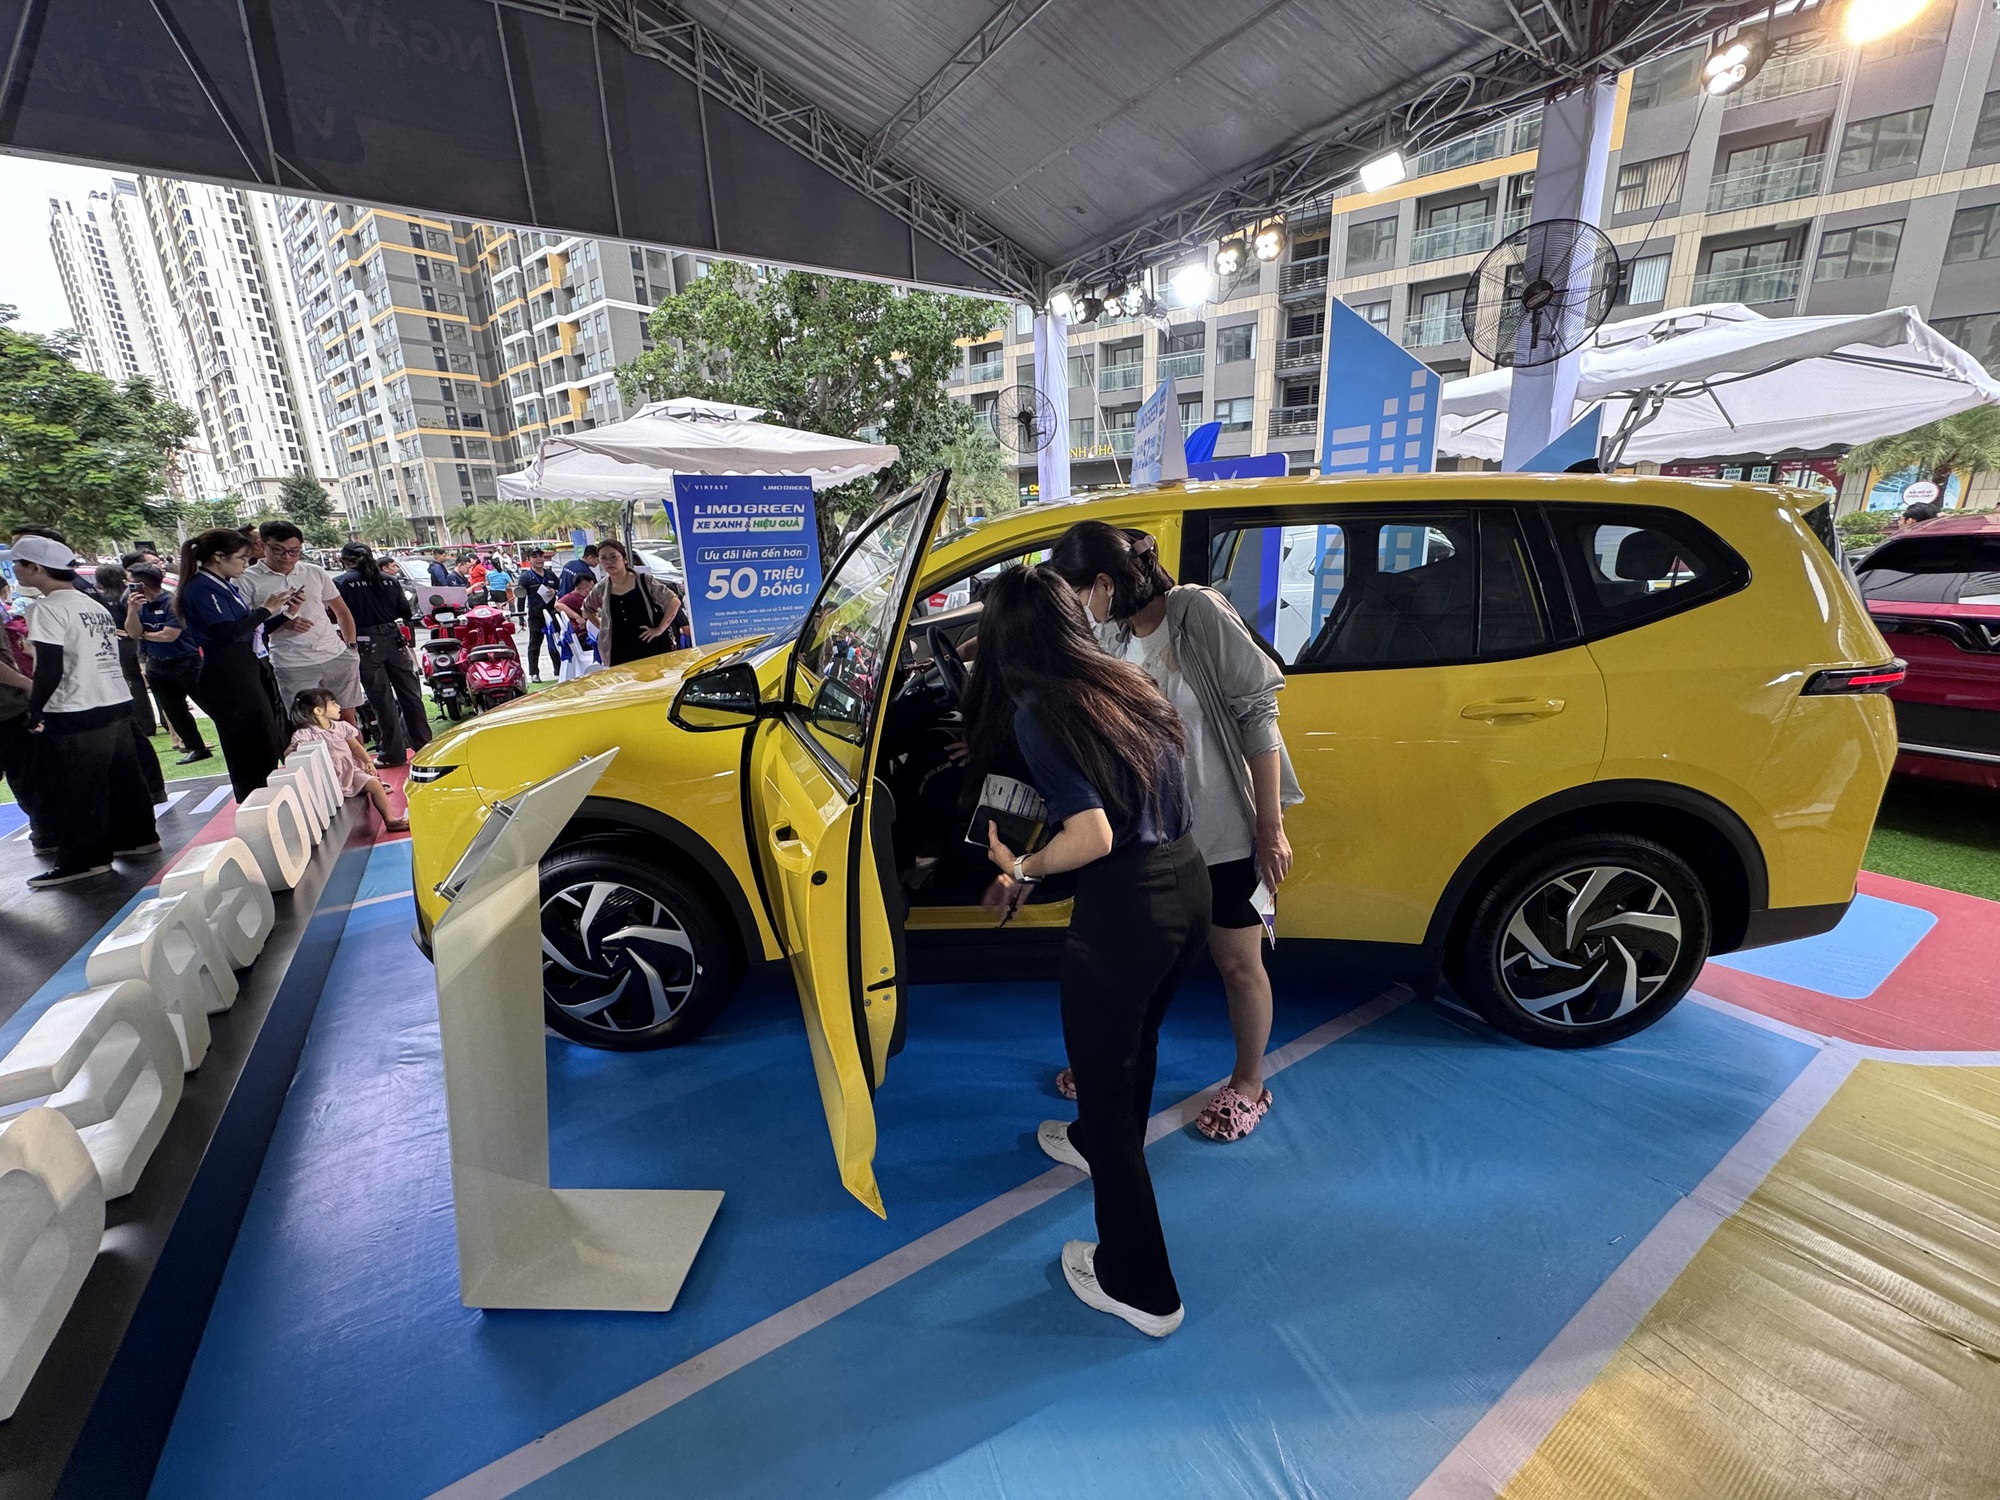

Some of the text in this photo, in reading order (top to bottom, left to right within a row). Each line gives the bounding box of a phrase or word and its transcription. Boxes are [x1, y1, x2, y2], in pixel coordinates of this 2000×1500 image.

[694, 503, 805, 515] LIMO GREEN
[696, 521, 711, 529] XE
[713, 520, 743, 529] XANH
[753, 518, 777, 529] HIỆU
[778, 516, 800, 528] QUẢ
[704, 547, 803, 560] Ưu đãi lên đến hơn
[762, 565, 805, 583] TRIỆU
[704, 566, 758, 601] 50
[760, 580, 803, 598] ĐỒNG
